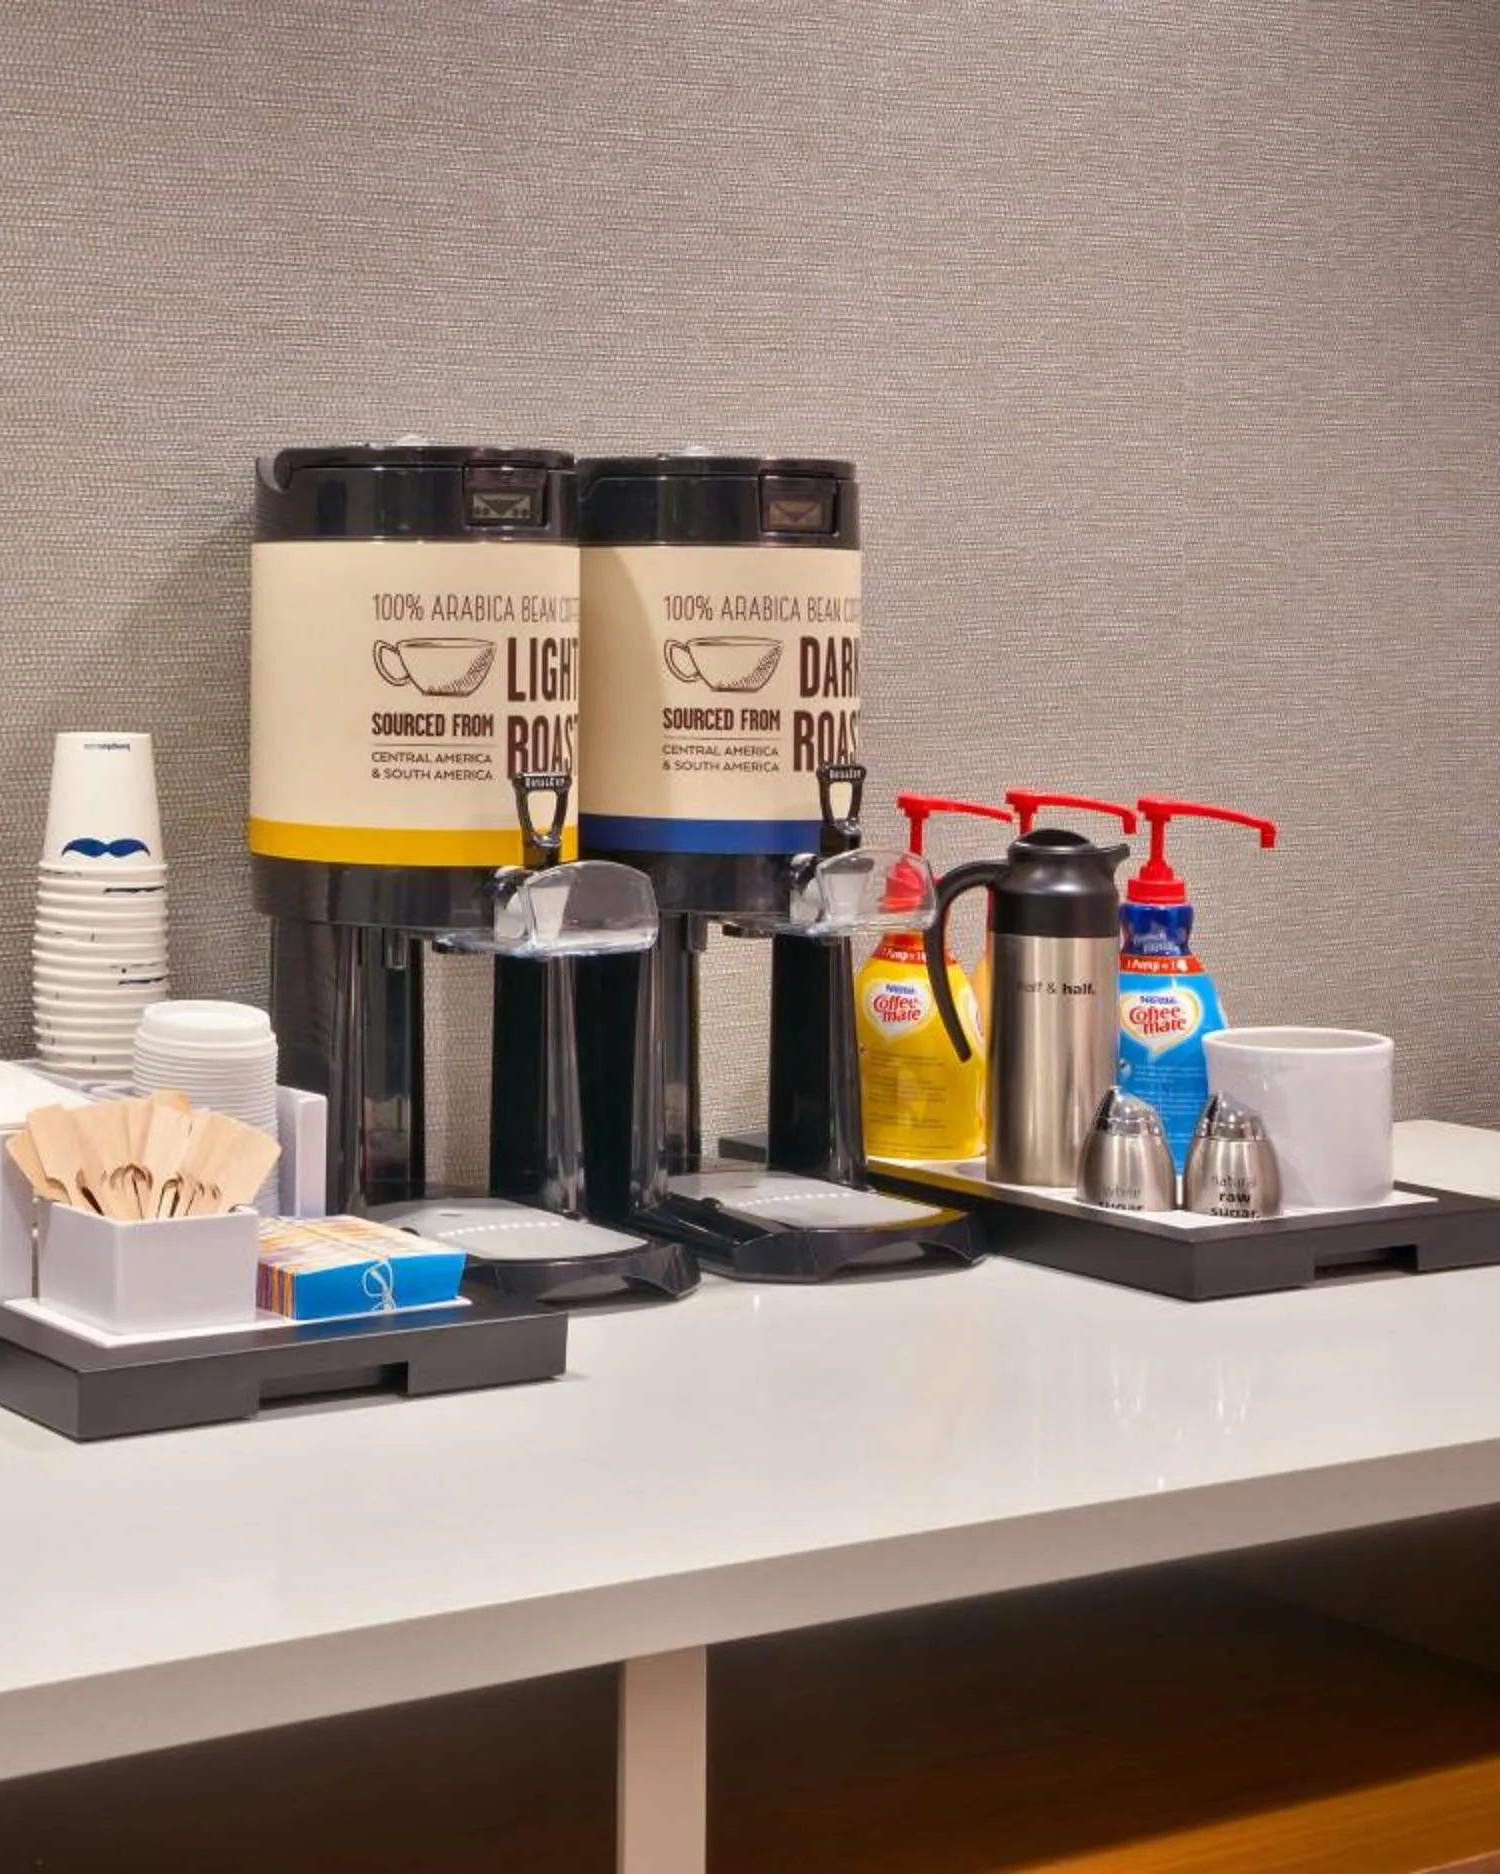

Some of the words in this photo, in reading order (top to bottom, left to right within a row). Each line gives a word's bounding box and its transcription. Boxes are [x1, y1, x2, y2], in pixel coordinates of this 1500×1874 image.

[372, 593, 425, 622] 100%
[431, 593, 516, 623] ARABICA
[521, 595, 557, 624] BEAN
[664, 594, 713, 622] 100%
[721, 594, 801, 623] ARABICA
[808, 596, 841, 624] BEAN
[507, 636, 579, 702] LIGHT
[371, 712, 445, 737] SOURCED
[452, 712, 494, 737] FROM
[662, 707, 735, 732] SOURCED
[741, 708, 781, 731] FROM
[793, 709, 860, 773] ROAS
[371, 751, 432, 764] CENTRAL
[435, 752, 493, 764] AMERICA
[662, 743, 719, 757] CENTRAL
[724, 745, 779, 757] AMERICA
[371, 767, 381, 780] &
[384, 767, 431, 780] SOUTH
[434, 768, 494, 781] AMERICA
[662, 759, 671, 771] &
[674, 759, 720, 772] SOUTH
[723, 761, 780, 773] AMERICA
[883, 1008, 921, 1023] mate
[1143, 1018, 1188, 1035] mate
[1218, 1191, 1252, 1203] raw
